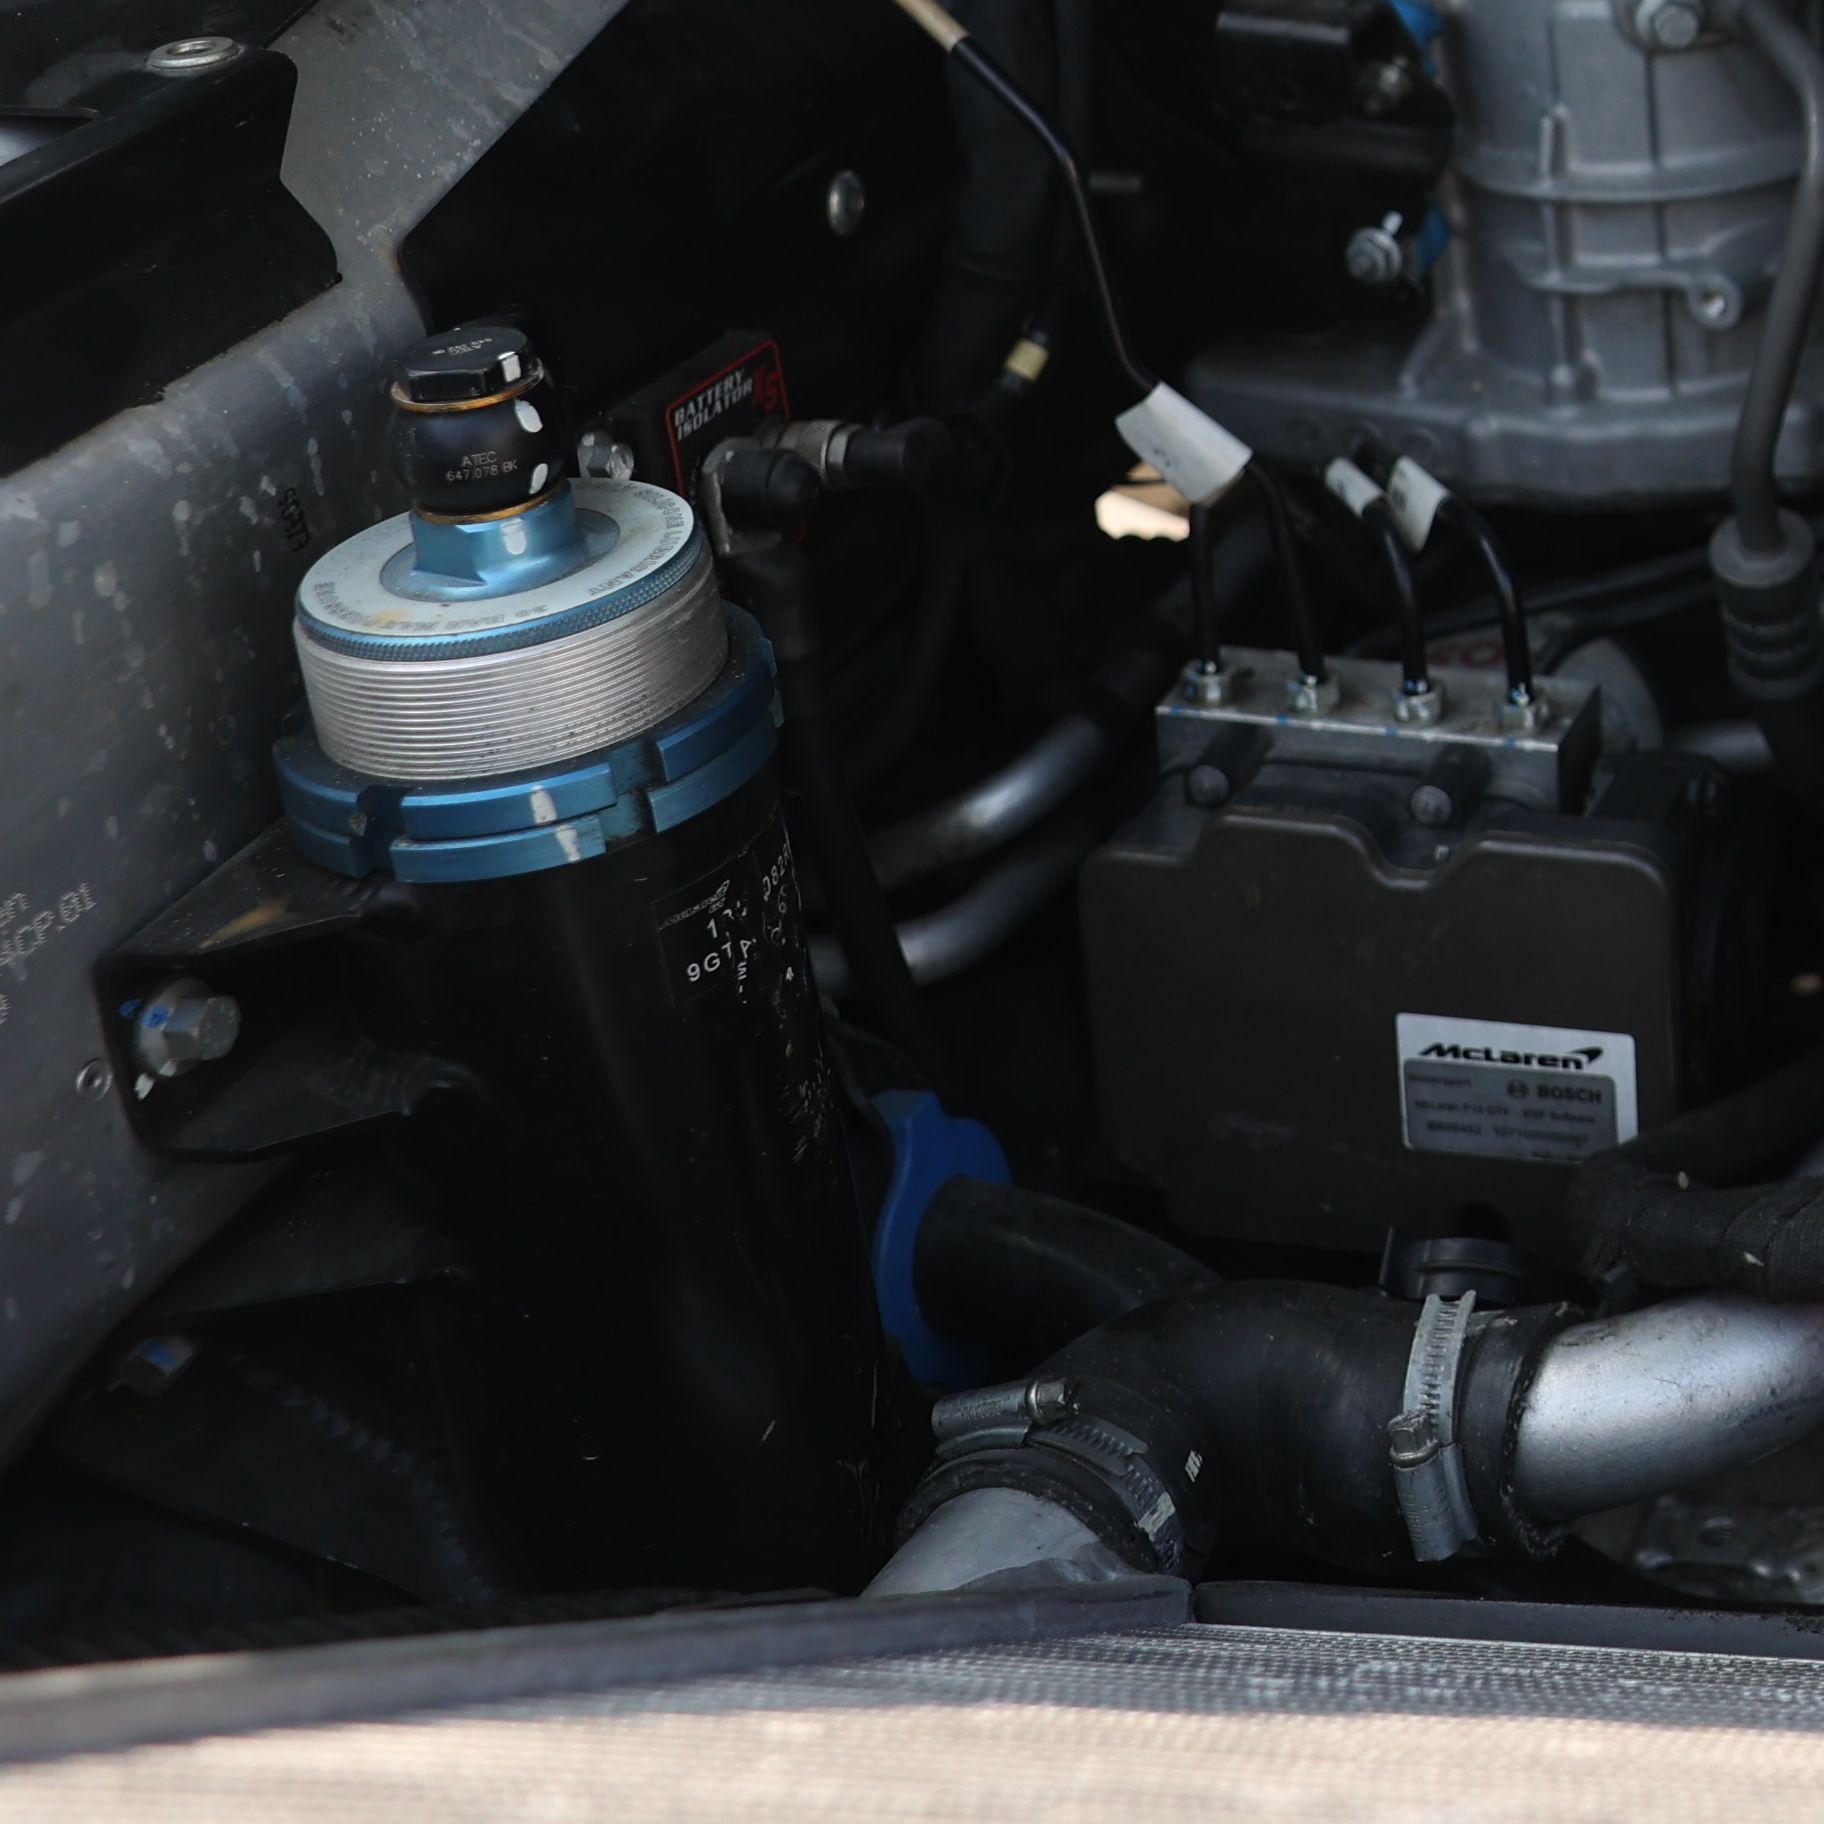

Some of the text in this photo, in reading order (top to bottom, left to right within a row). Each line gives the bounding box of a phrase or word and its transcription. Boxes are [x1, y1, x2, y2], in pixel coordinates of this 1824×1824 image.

[674, 367, 745, 428] BATTERY
[677, 377, 753, 442] ISOLATOR
[461, 451, 497, 467] ATEC
[1420, 1042, 1585, 1070] McLaren
[1537, 1084, 1603, 1103] BOSCH
